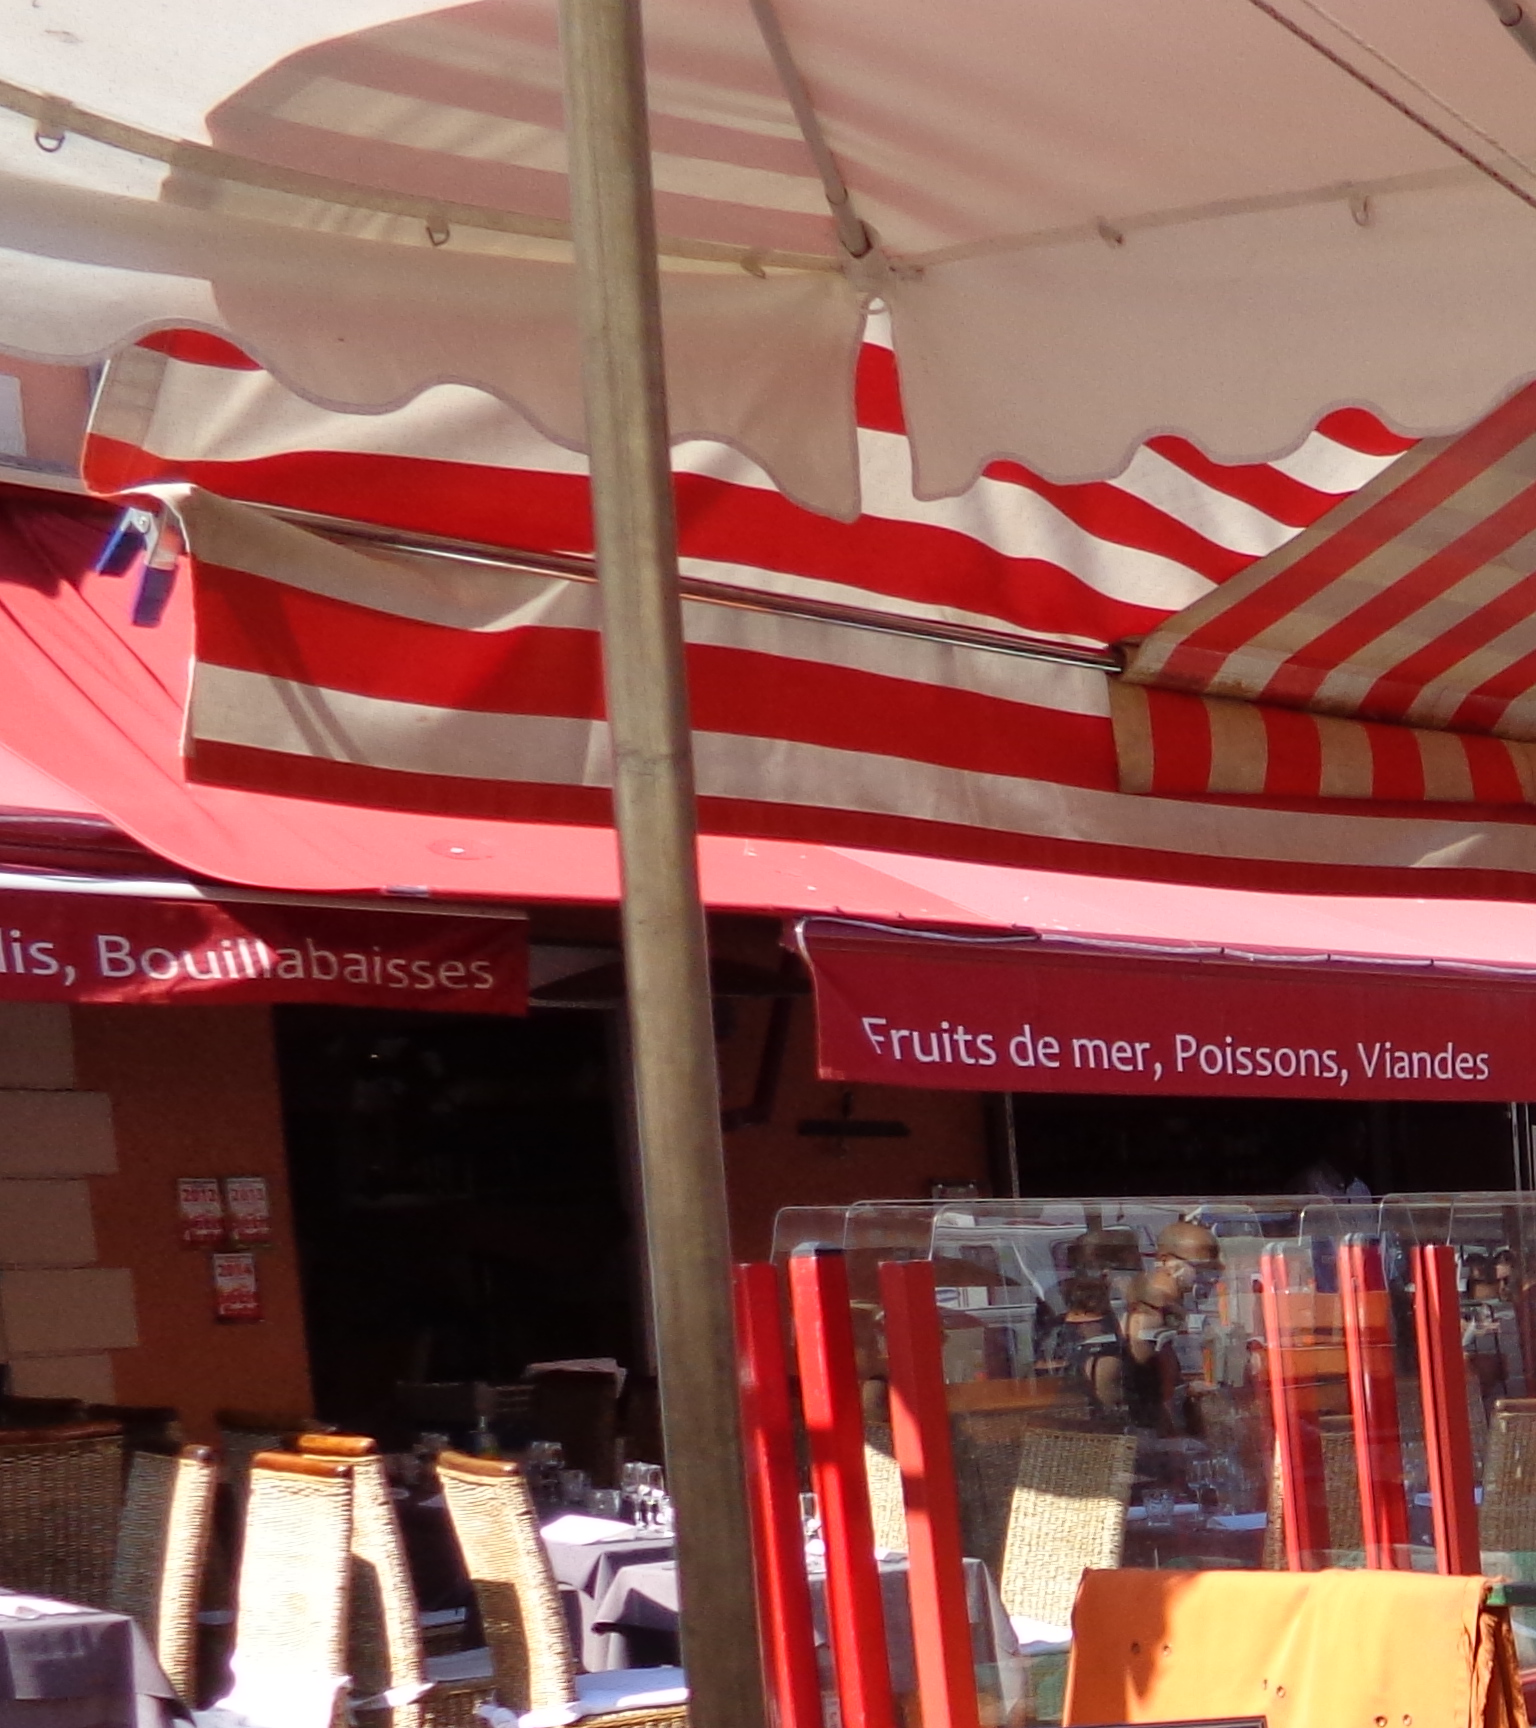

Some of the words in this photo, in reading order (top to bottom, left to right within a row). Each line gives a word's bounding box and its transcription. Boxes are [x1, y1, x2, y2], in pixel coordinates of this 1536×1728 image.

[98, 934, 495, 990] Bouillabaisses
[862, 1016, 998, 1067] Fruits
[1009, 1024, 1060, 1068] de
[1073, 1036, 1163, 1082] mer,
[1175, 1033, 1349, 1087] Poissons,
[1357, 1041, 1489, 1080] Viandes
